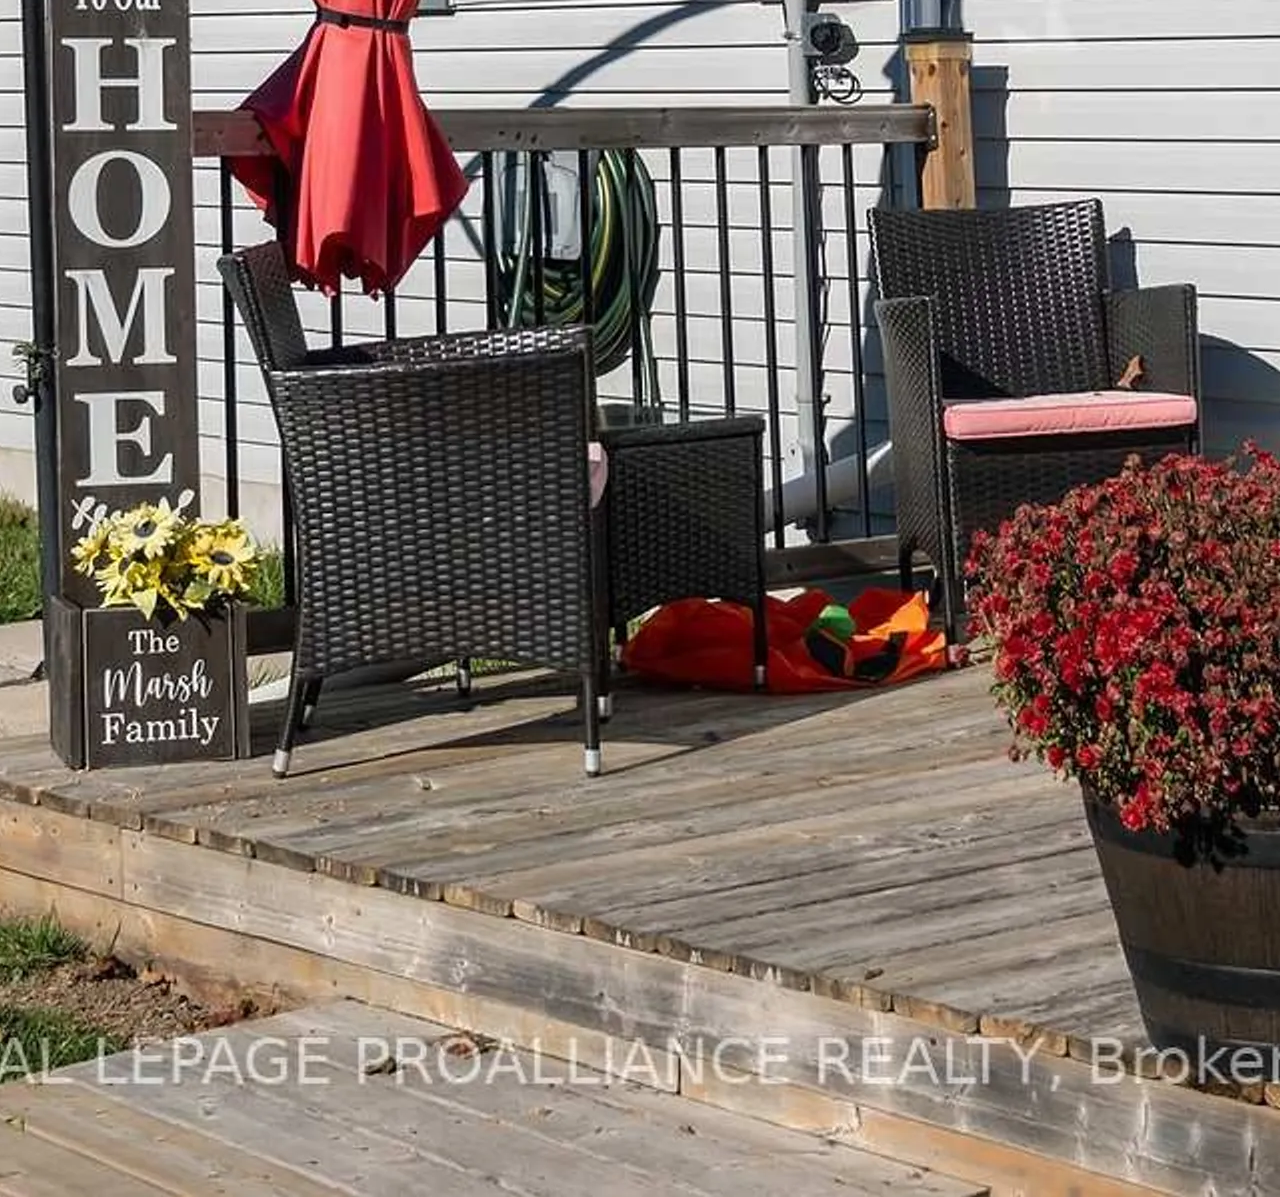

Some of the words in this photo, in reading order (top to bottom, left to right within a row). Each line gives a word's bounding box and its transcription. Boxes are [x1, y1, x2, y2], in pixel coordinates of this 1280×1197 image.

[61, 38, 178, 488] HOME
[128, 629, 180, 655] The
[103, 658, 214, 709] Marsh
[100, 707, 220, 746] Family
